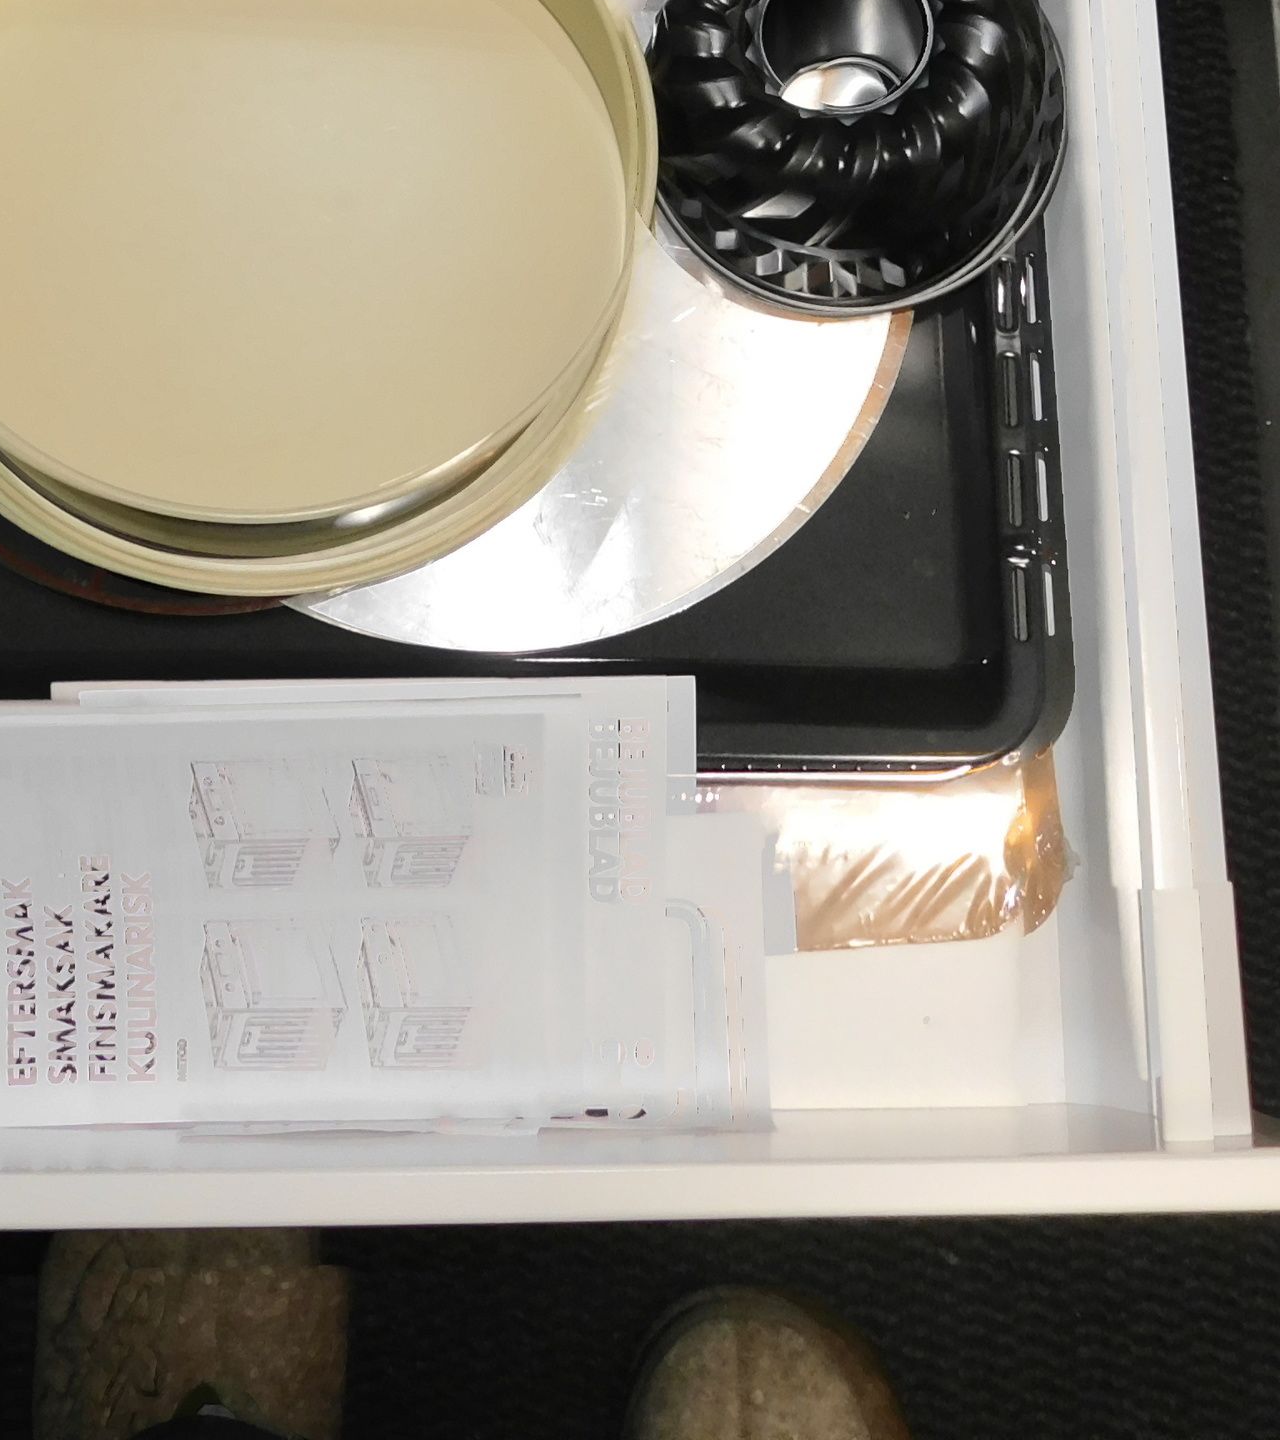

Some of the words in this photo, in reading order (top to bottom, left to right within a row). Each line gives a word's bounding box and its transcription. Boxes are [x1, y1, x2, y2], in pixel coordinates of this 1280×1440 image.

[588, 720, 621, 903] BEJUBLAD
[1, 878, 37, 1085] EFTERSMAK
[44, 905, 77, 1084] SMAKSAK
[80, 855, 117, 1082] FINSMAKARE
[121, 872, 157, 1082] KULINARISK
